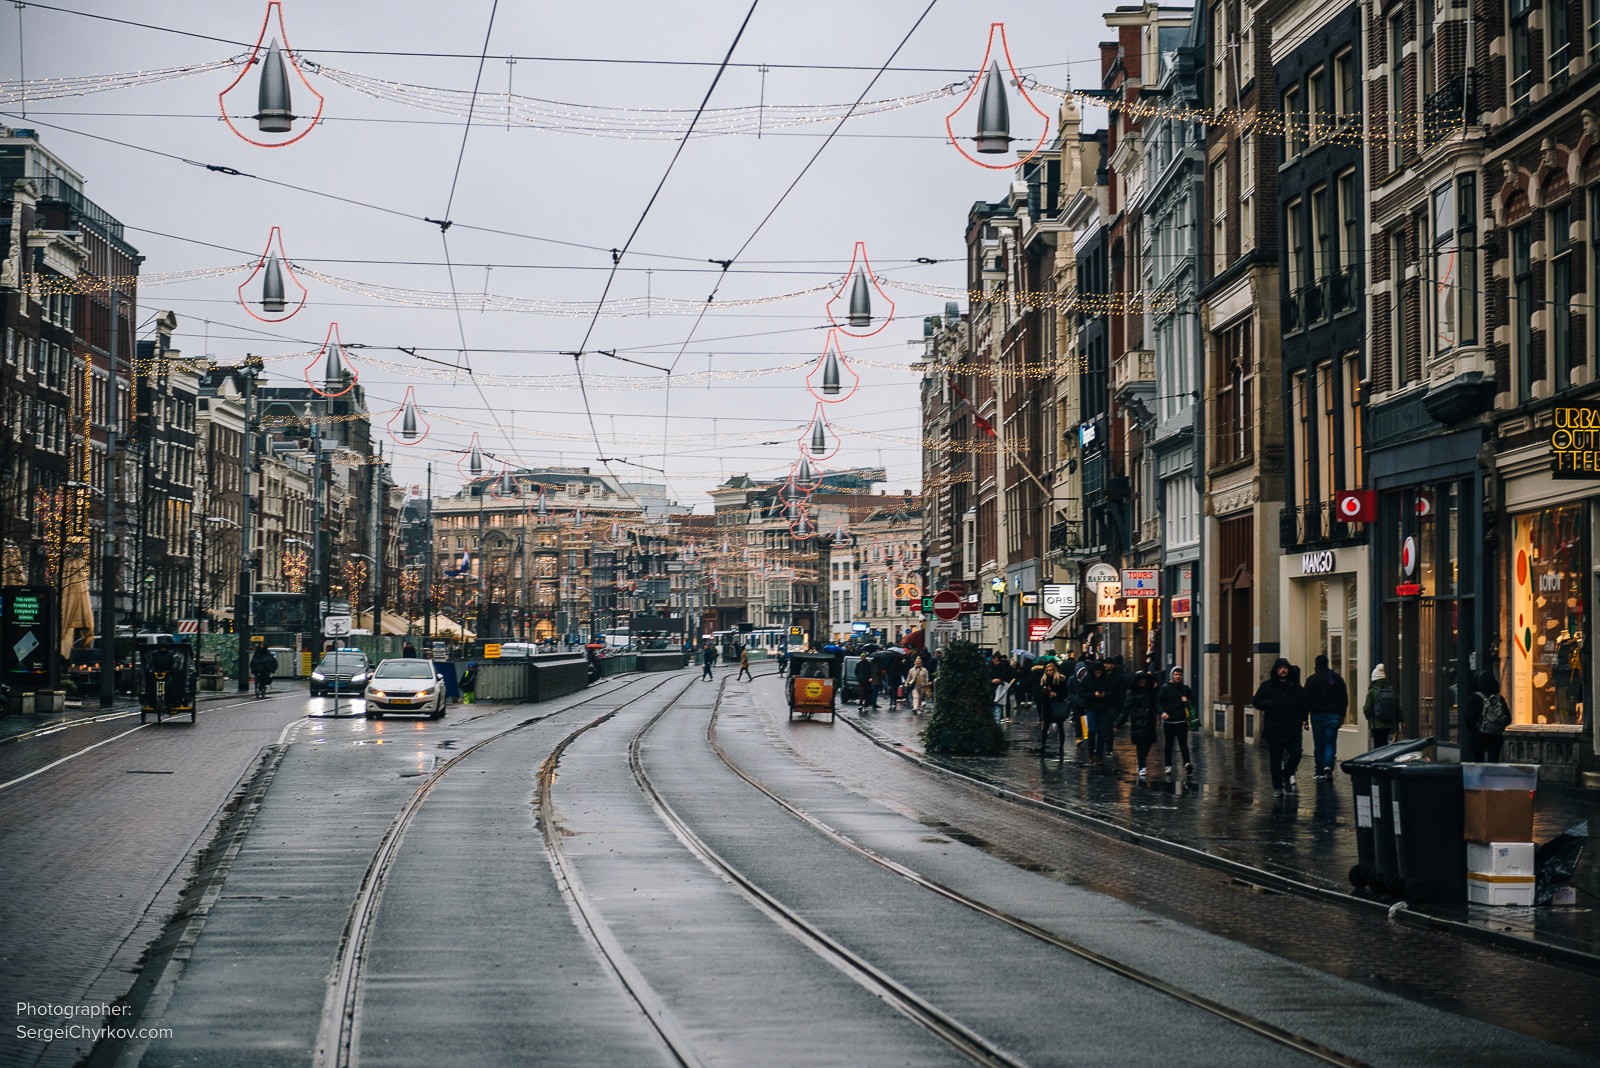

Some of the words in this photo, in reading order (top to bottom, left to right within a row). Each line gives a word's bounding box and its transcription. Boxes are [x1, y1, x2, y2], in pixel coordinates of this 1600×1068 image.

[1552, 429, 1600, 449] OUT
[1302, 551, 1333, 574] MANGO
[1087, 575, 1118, 583] BAKERY
[1127, 571, 1153, 579] TOURS
[1136, 580, 1144, 588] &
[1103, 586, 1121, 599] SUP
[1124, 588, 1156, 597] TICKETS
[1046, 596, 1073, 605] ORIS
